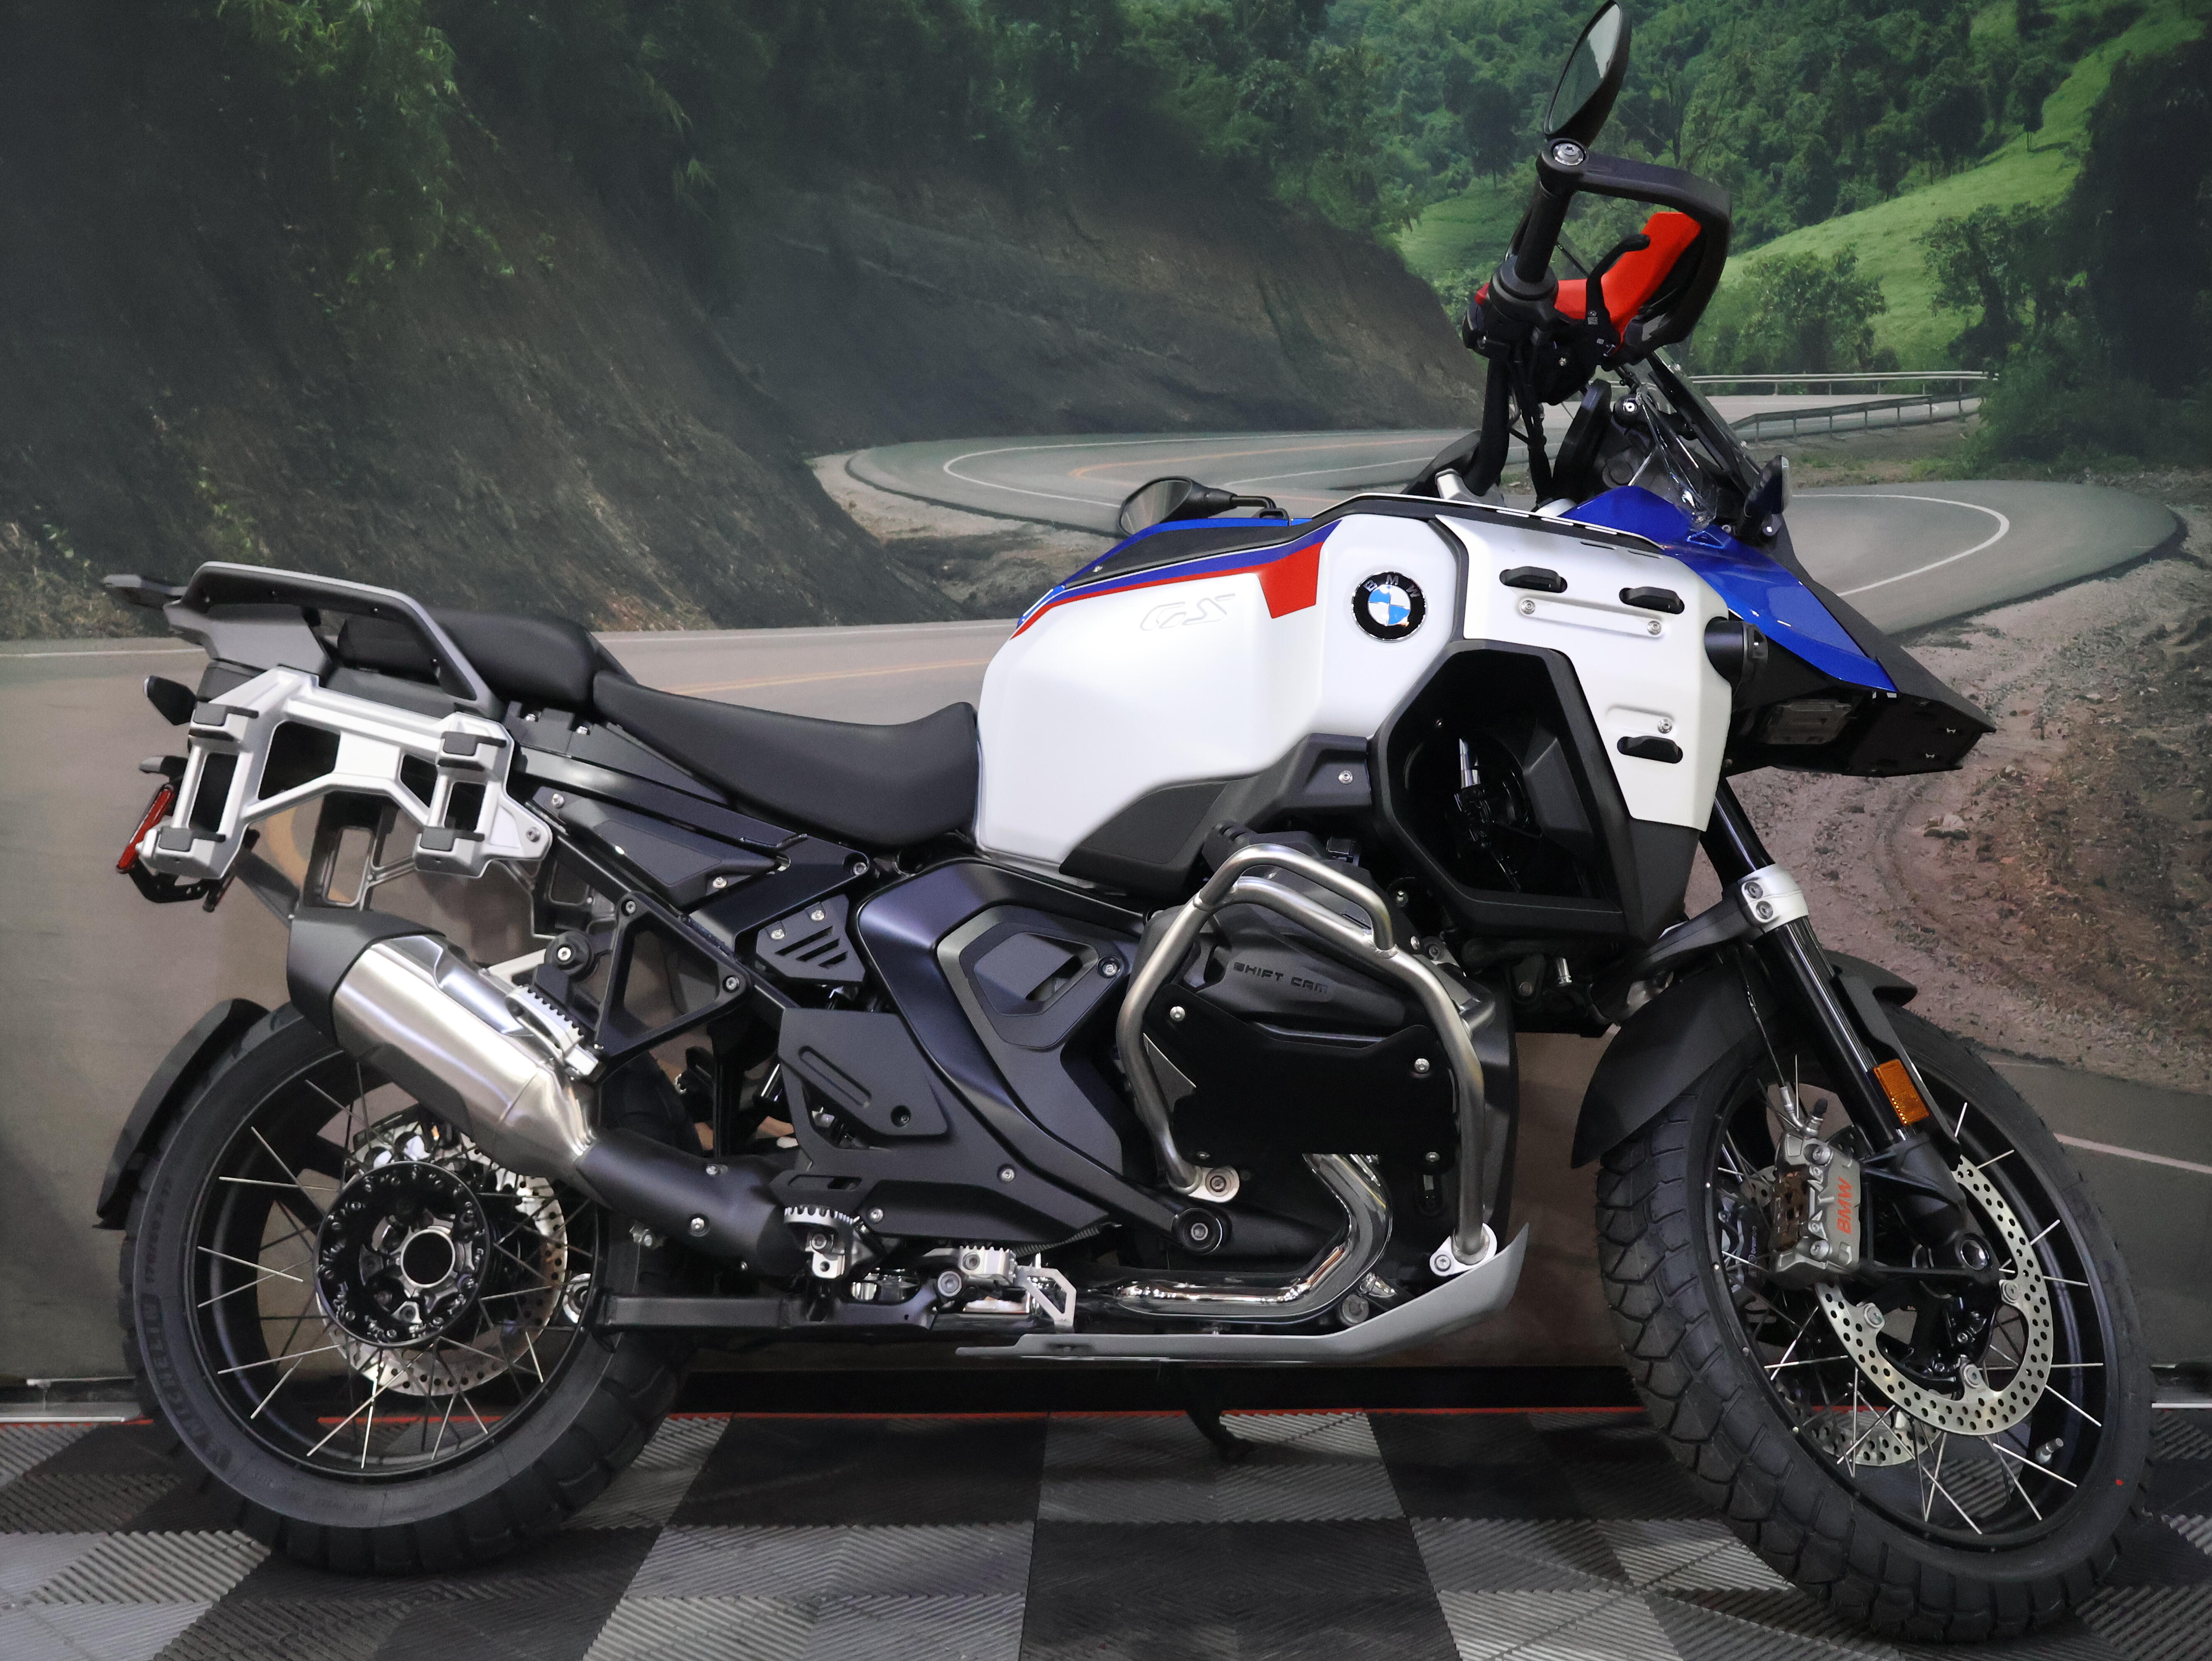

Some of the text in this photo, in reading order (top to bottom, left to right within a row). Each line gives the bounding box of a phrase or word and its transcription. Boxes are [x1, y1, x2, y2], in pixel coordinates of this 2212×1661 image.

[1363, 575, 1420, 598] BMW
[1140, 593, 1236, 631] GS
[1233, 962, 1328, 994] SHIFT CAM
[1837, 1176, 1853, 1234] BMW
[143, 1301, 206, 1437] MICHELIN
